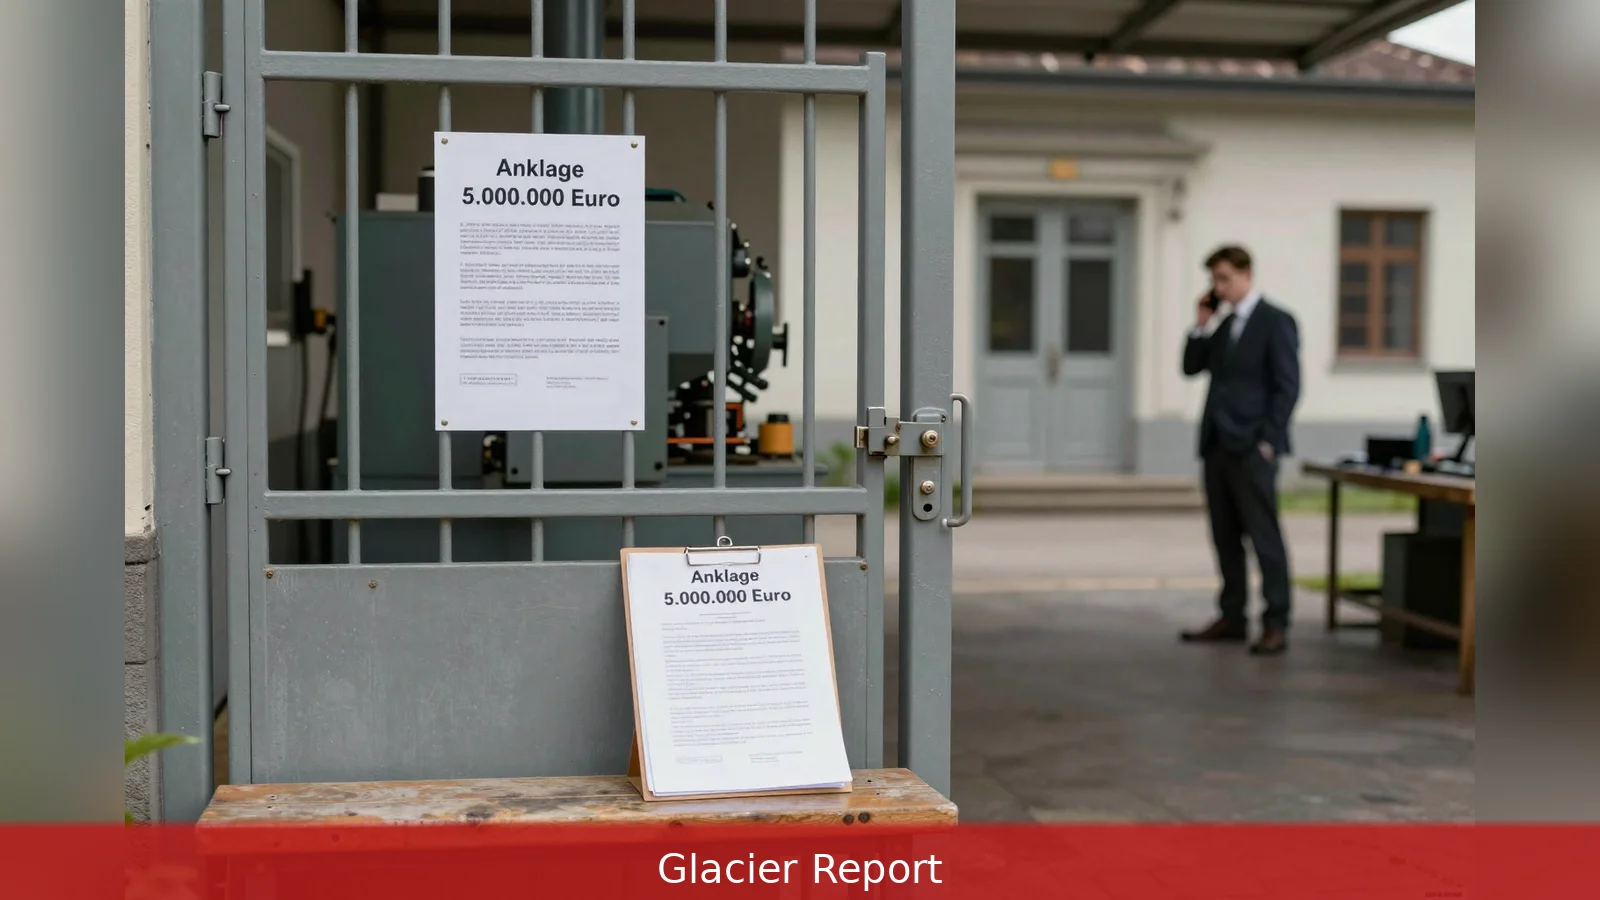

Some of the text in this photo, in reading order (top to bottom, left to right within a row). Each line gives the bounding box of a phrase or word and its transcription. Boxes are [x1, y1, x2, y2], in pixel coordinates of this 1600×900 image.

[496, 158, 585, 182] Anklage
[461, 187, 621, 208] 5.000.000 Euro
[690, 568, 760, 586] Anklage
[664, 589, 792, 606] 5.000.000 Euro
